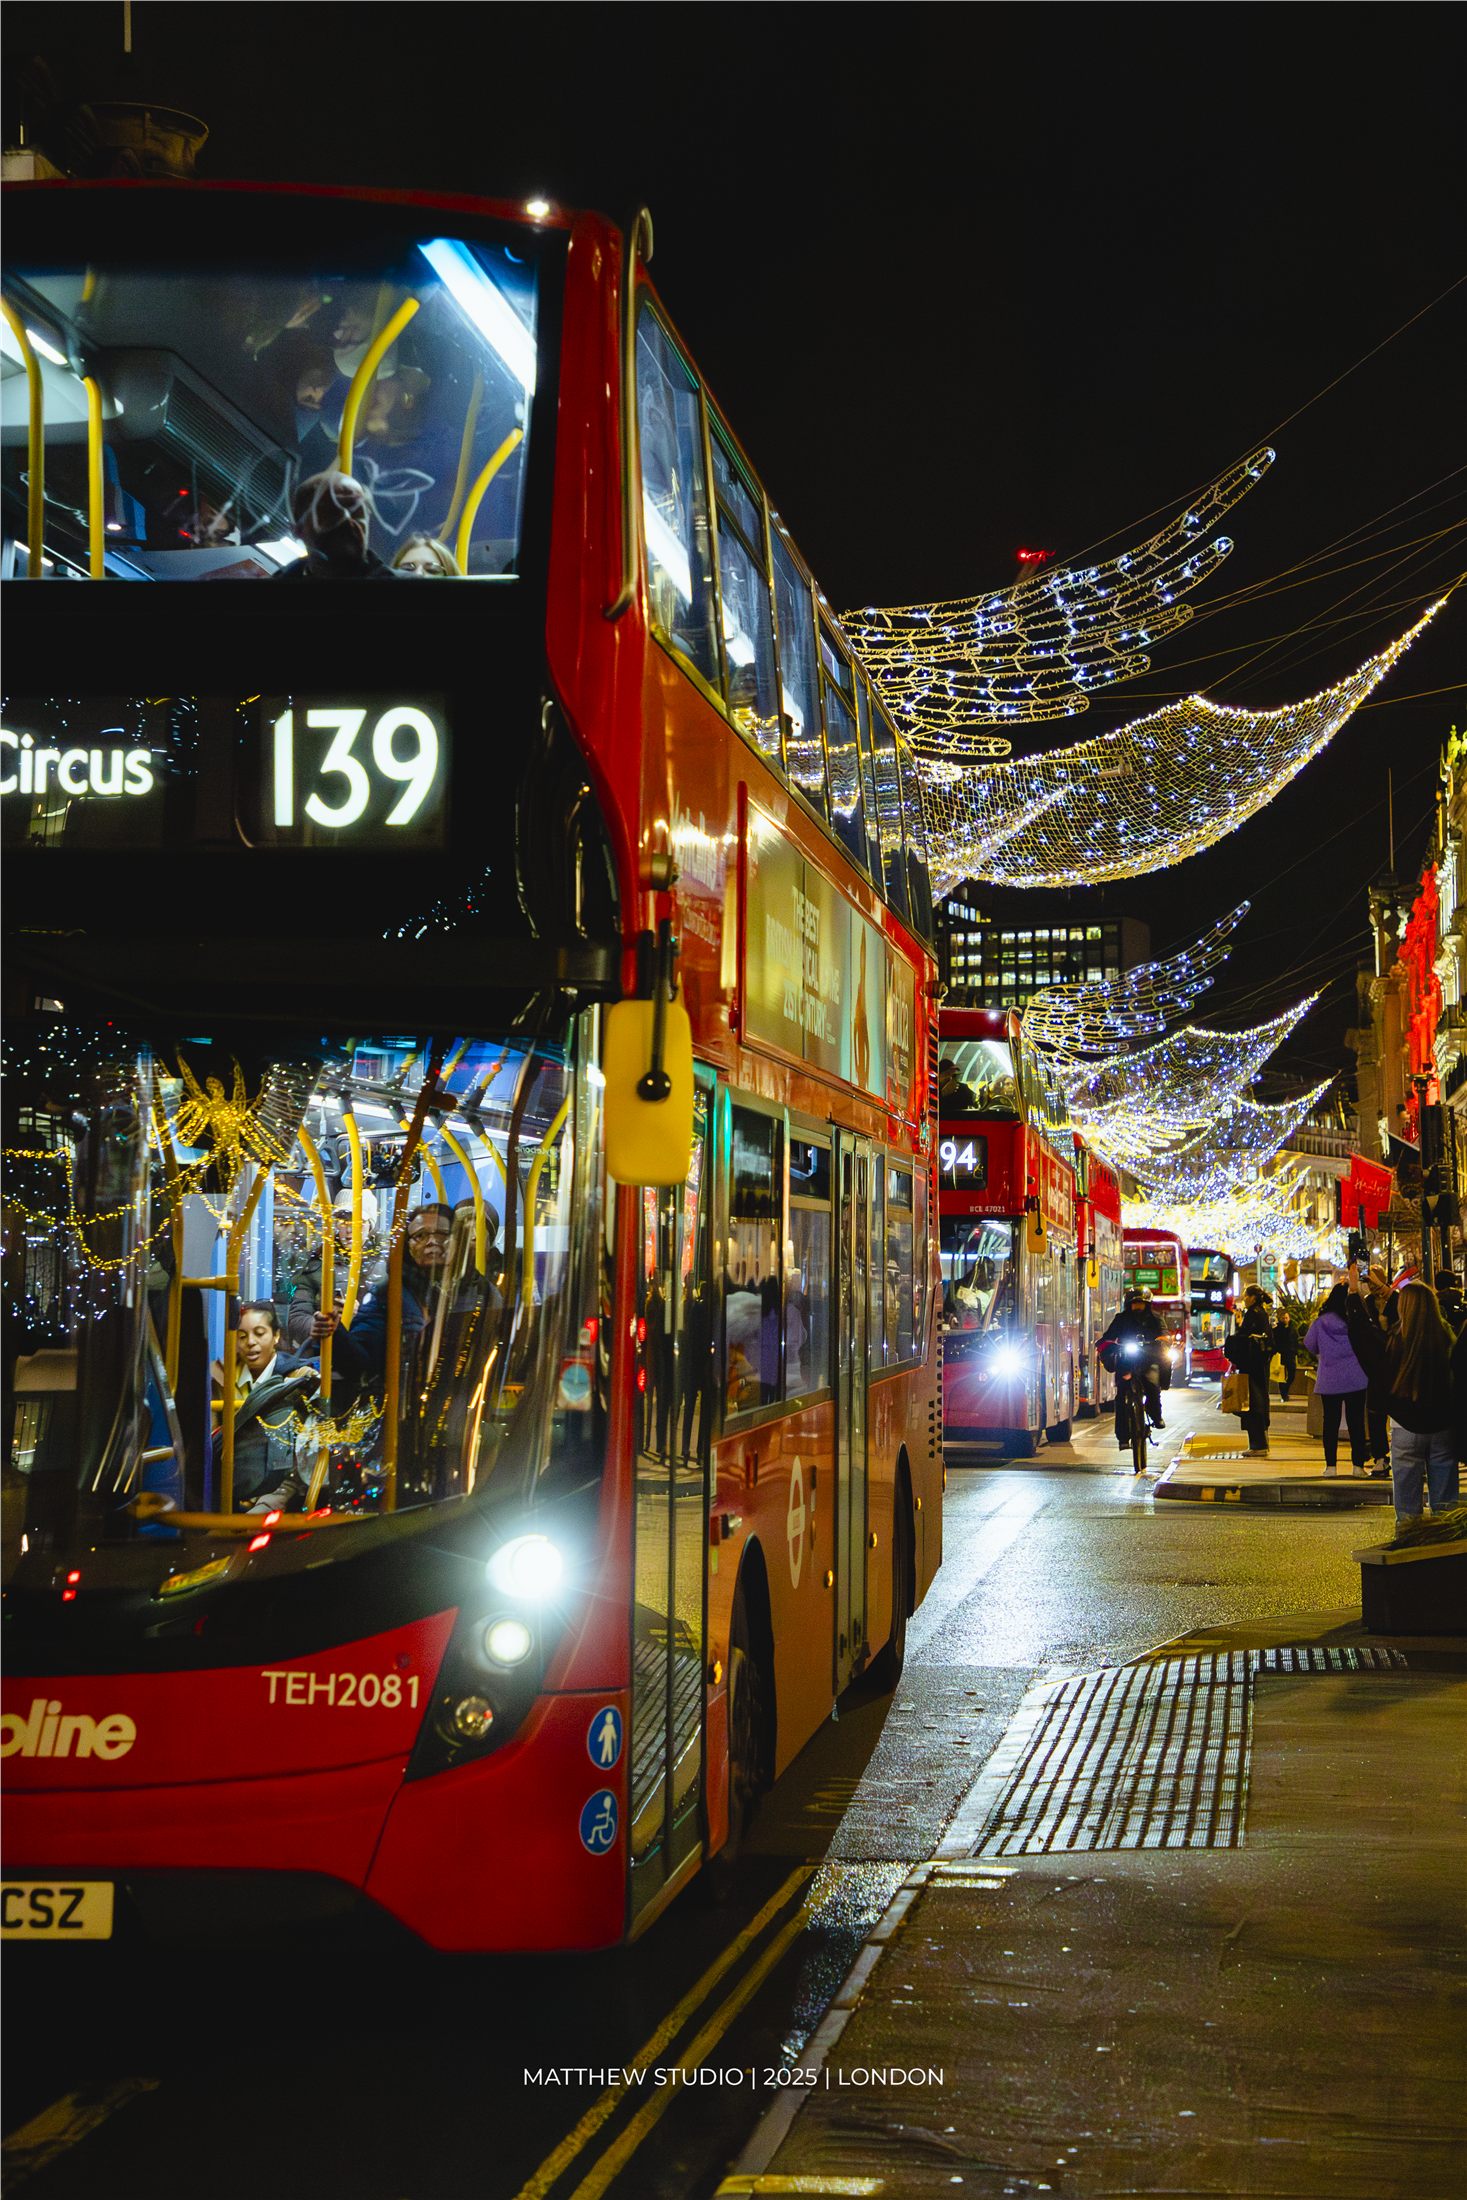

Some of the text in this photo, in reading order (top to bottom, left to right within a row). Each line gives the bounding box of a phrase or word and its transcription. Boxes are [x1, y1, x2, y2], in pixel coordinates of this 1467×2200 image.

[274, 706, 439, 828] 139
[805, 898, 820, 945] BEST
[940, 1141, 978, 1171] 94
[984, 1205, 1006, 1213] 47021
[261, 1671, 420, 1709] TEH2081
[0, 1698, 137, 1760] oline
[1, 1888, 85, 1929] CSZ
